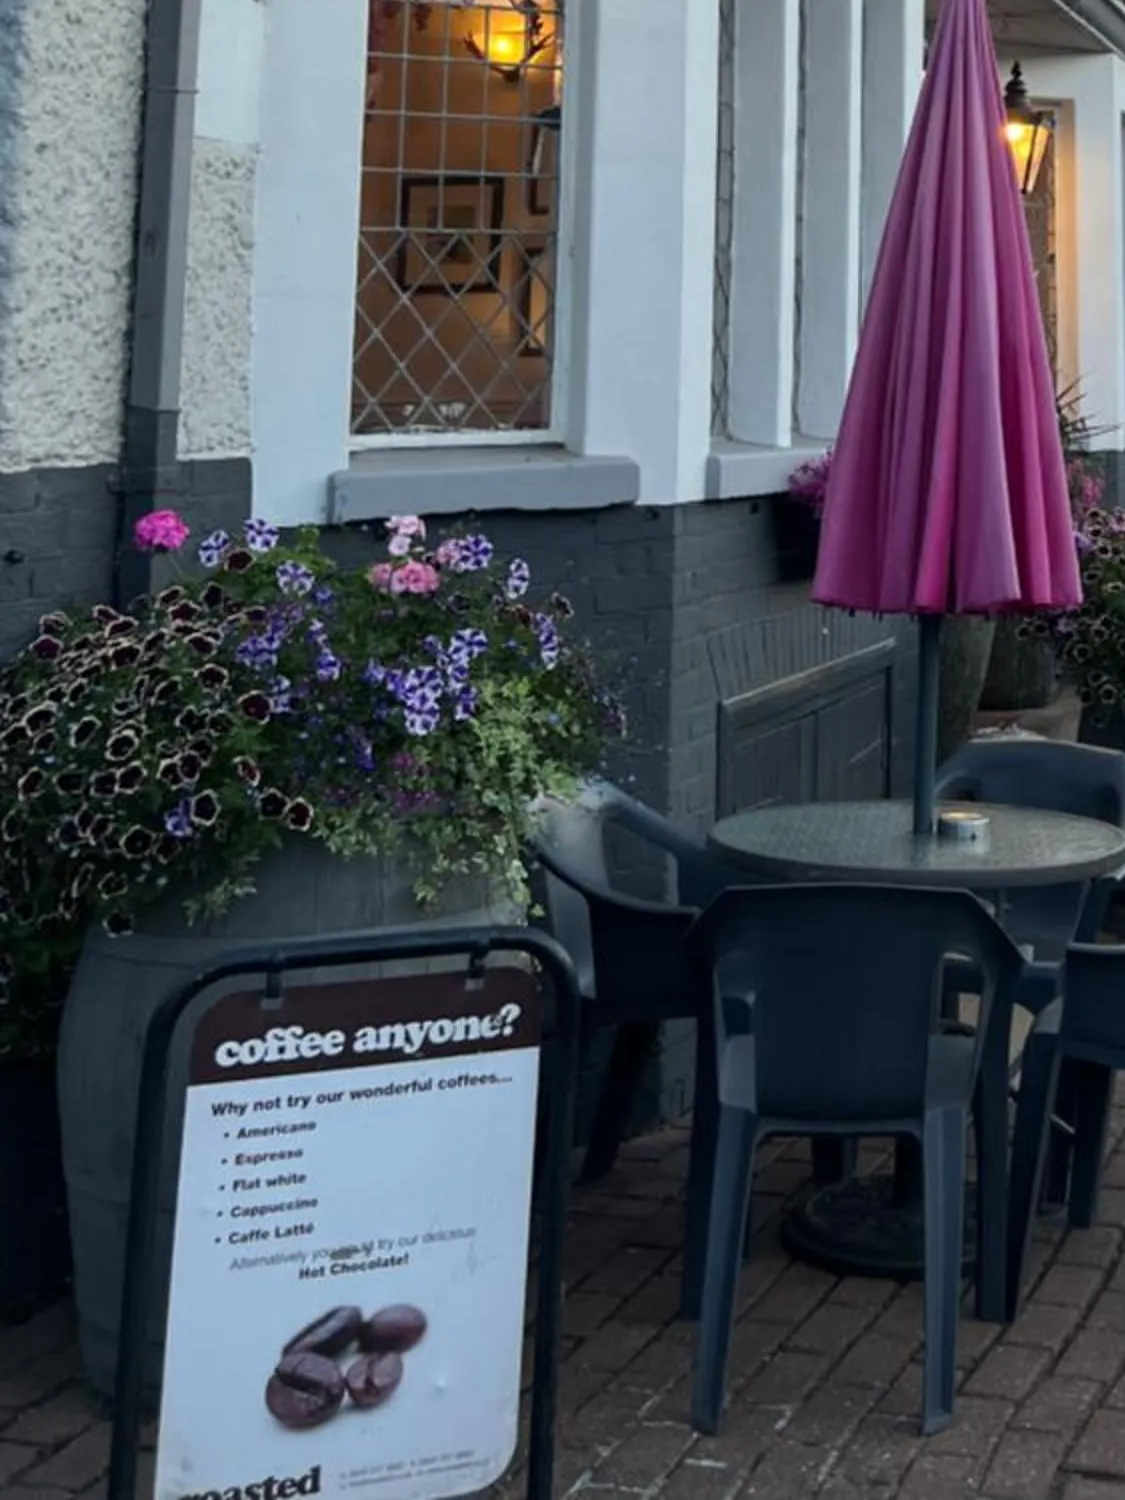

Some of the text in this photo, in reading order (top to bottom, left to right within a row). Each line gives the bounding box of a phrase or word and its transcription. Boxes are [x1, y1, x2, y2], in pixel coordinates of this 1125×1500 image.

[215, 1002, 521, 1067] coffee anyone?
[211, 1101, 248, 1116] Why
[253, 1096, 281, 1112] not
[287, 1093, 311, 1109] try
[315, 1091, 344, 1104] our
[350, 1077, 432, 1100] wonderful
[237, 1121, 317, 1139] Americano
[235, 1148, 304, 1166] Espresso
[232, 1172, 306, 1192] Flat white
[230, 1198, 318, 1218] Cappuccino
[298, 1252, 409, 1280] Hot Chocolate!
[178, 1464, 321, 1500] asted
